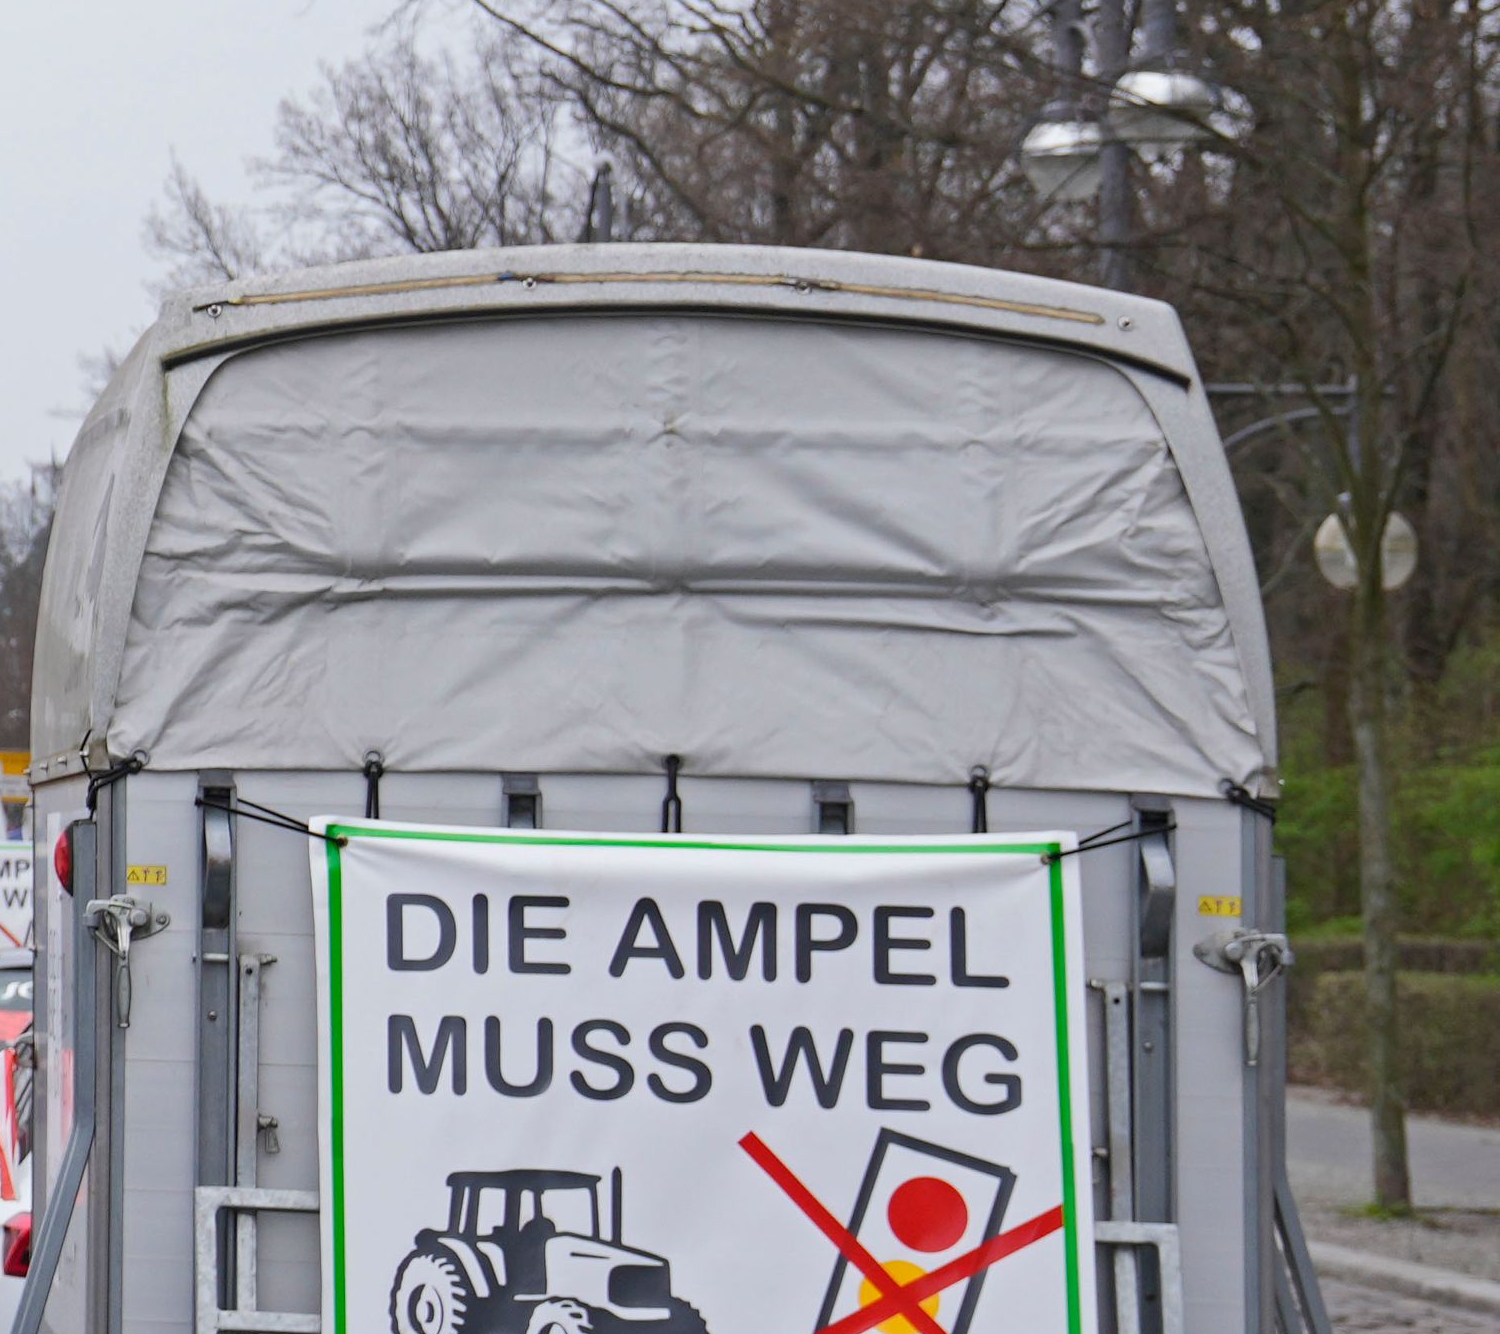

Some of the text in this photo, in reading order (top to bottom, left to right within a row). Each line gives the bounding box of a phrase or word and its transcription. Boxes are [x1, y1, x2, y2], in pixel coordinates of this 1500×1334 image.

[386, 892, 1010, 989] DIE AMPEL
[387, 1014, 1022, 1116] MUSS WEG
